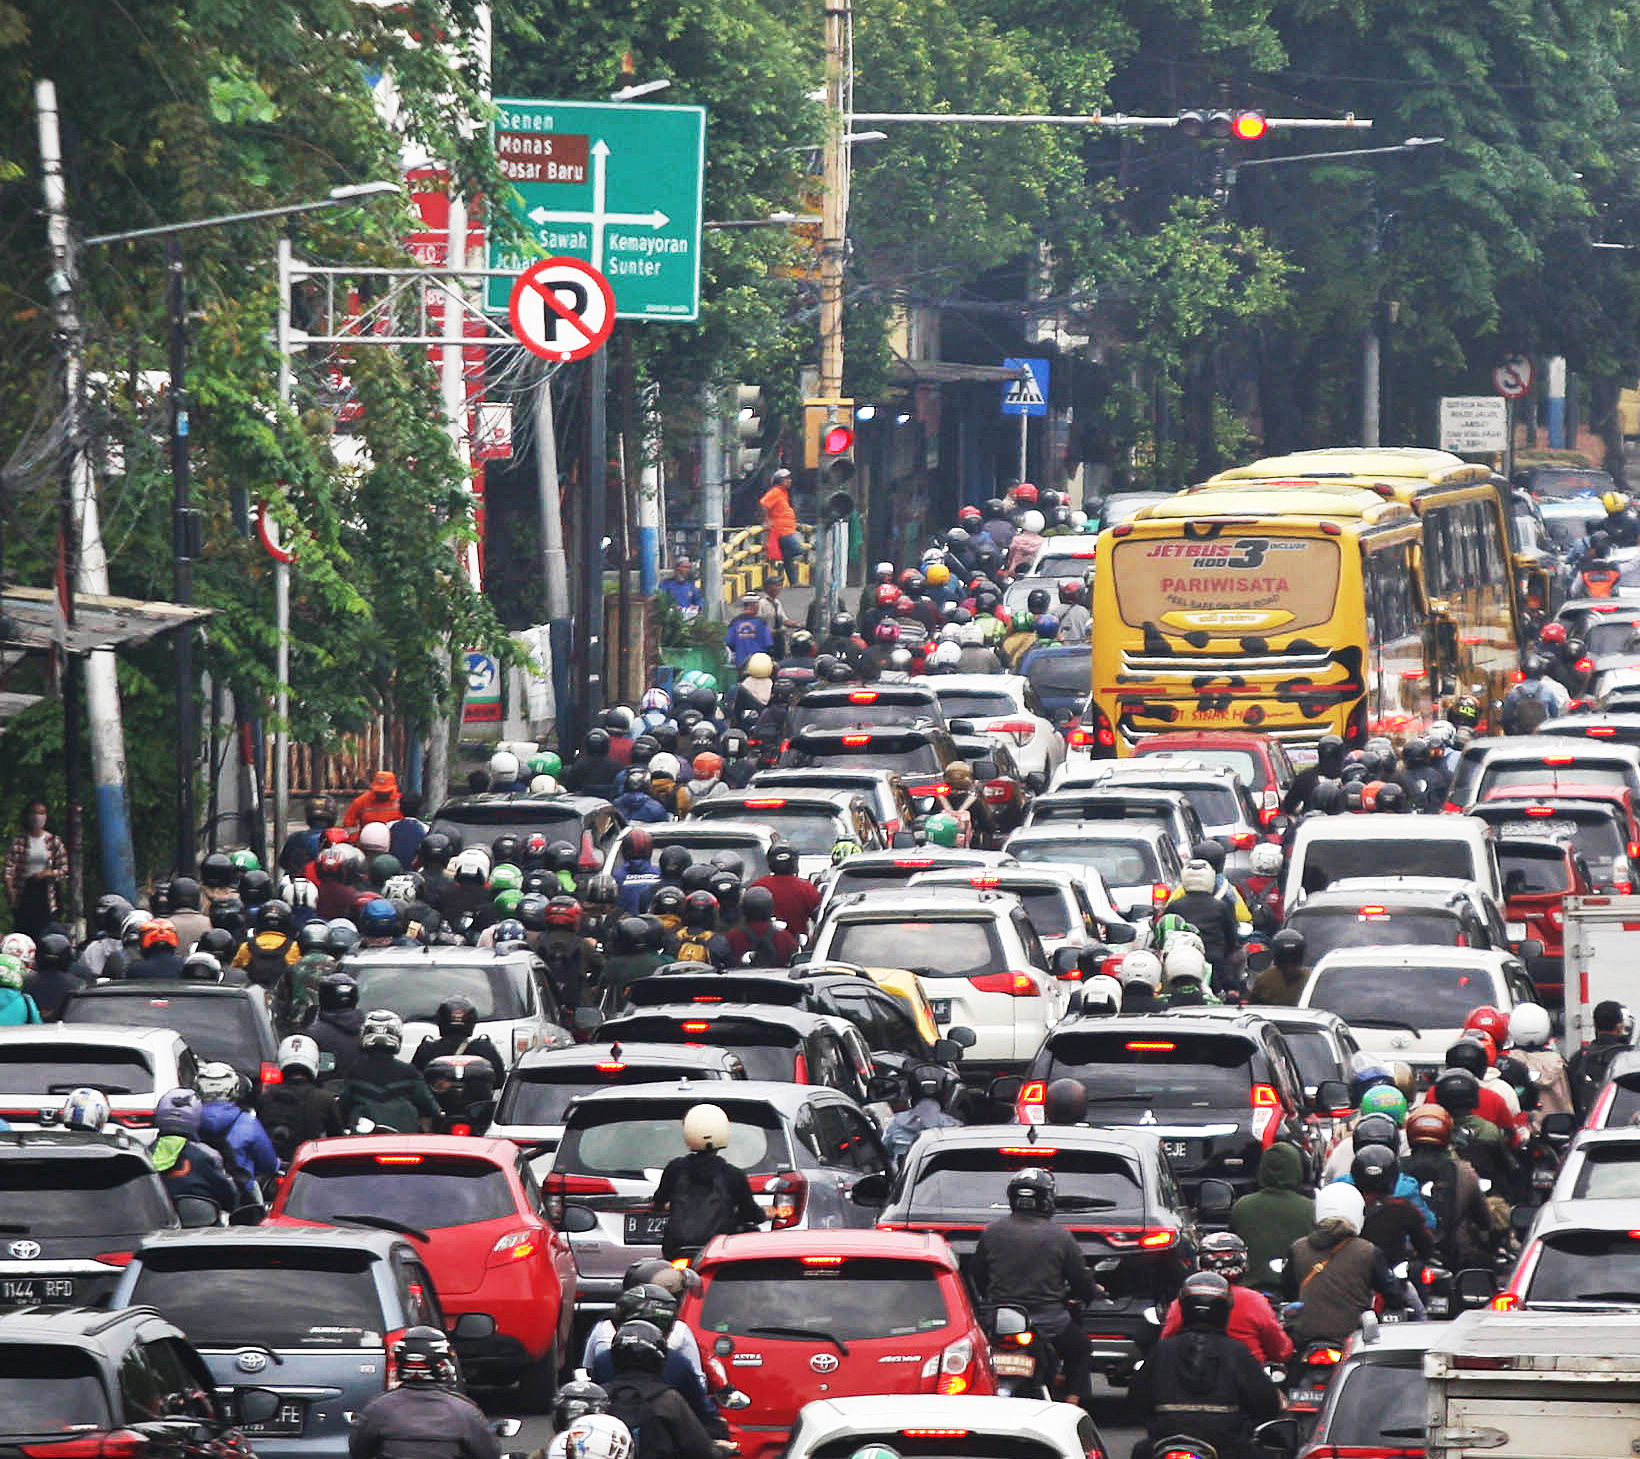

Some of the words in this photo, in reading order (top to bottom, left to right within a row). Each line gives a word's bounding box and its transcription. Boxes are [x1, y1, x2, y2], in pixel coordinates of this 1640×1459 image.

[500, 111, 553, 130] Senen
[500, 136, 552, 155] Monas
[500, 160, 541, 178] Pasar
[548, 163, 584, 180] Baru
[540, 230, 588, 248] Sawah
[610, 233, 688, 256] Kemayoran
[610, 258, 661, 276] Sunter
[1146, 544, 1232, 558] JETBUS
[1192, 557, 1227, 568] HDD
[1161, 577, 1290, 593] PARIWISATA
[628, 1217, 637, 1231] B
[46, 1281, 73, 1296] RFD
